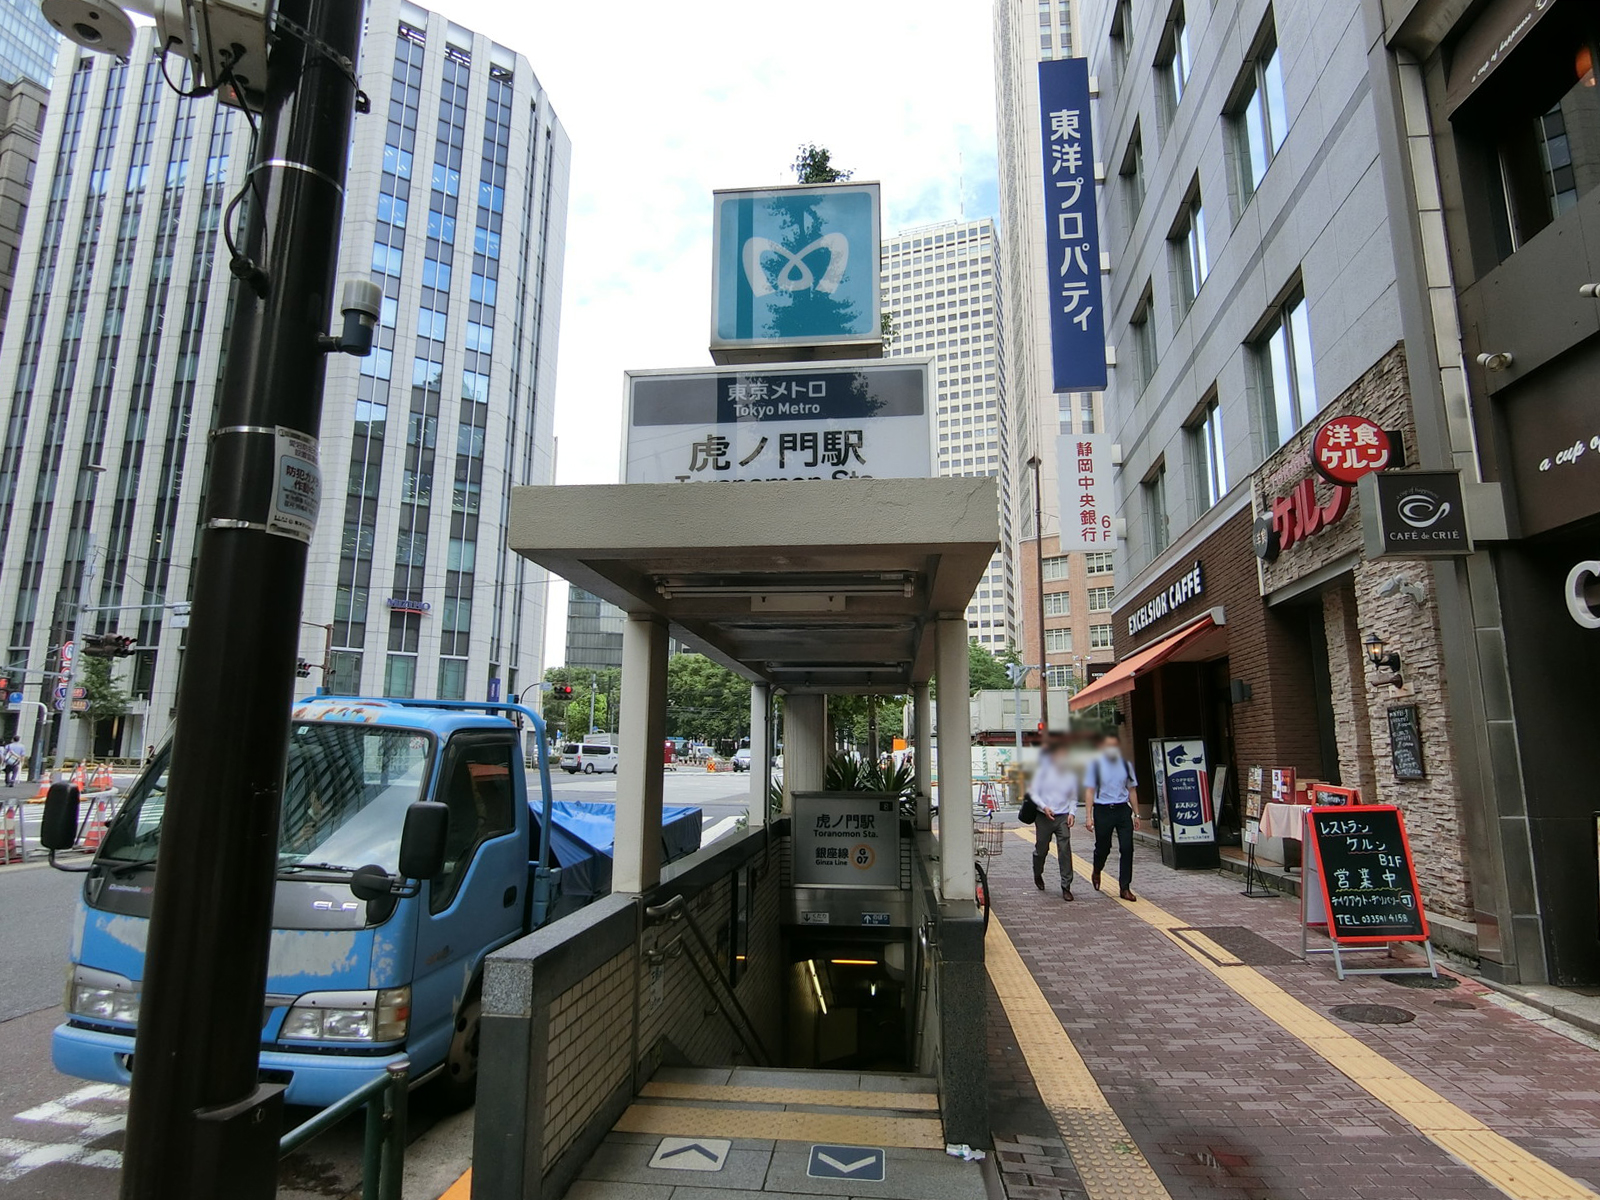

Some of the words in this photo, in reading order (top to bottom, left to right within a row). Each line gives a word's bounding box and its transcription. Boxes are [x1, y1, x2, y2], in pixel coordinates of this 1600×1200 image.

[1049, 109, 1093, 331] 東洋プロパティ
[727, 380, 826, 401] 東京メトロ
[733, 404, 774, 418] Tokyo
[778, 402, 820, 414] Metro
[1326, 423, 1379, 447] 洋食
[688, 429, 866, 472] 虎ノ門駅
[1539, 458, 1551, 471] a
[1555, 440, 1585, 465] cup
[1321, 448, 1388, 469] ケルン
[1076, 442, 1097, 542] 静岡中央銀行
[1273, 477, 1350, 550] ケルン
[1101, 515, 1111, 541] 6F
[1389, 530, 1418, 540] CAFÉ
[1421, 531, 1430, 540] de
[1432, 530, 1460, 540] CRIÉ
[1128, 592, 1168, 636] EXCELSIOR
[1169, 561, 1202, 610] CAFFÉ
[883, 802, 889, 810] 8
[816, 814, 875, 829] 虎ノ門駅
[1176, 811, 1199, 820] ケルン
[813, 830, 860, 838] Toranomon
[863, 830, 878, 838] Sta.
[1320, 820, 1369, 835] レストラン
[1346, 837, 1386, 851] ケルン
[815, 847, 849, 859] 銀座線
[856, 856, 868, 864] 07
[1378, 854, 1402, 868] B1F
[1334, 868, 1396, 889] 営業中
[313, 900, 359, 911] ELF
[1336, 914, 1360, 925] TEL
